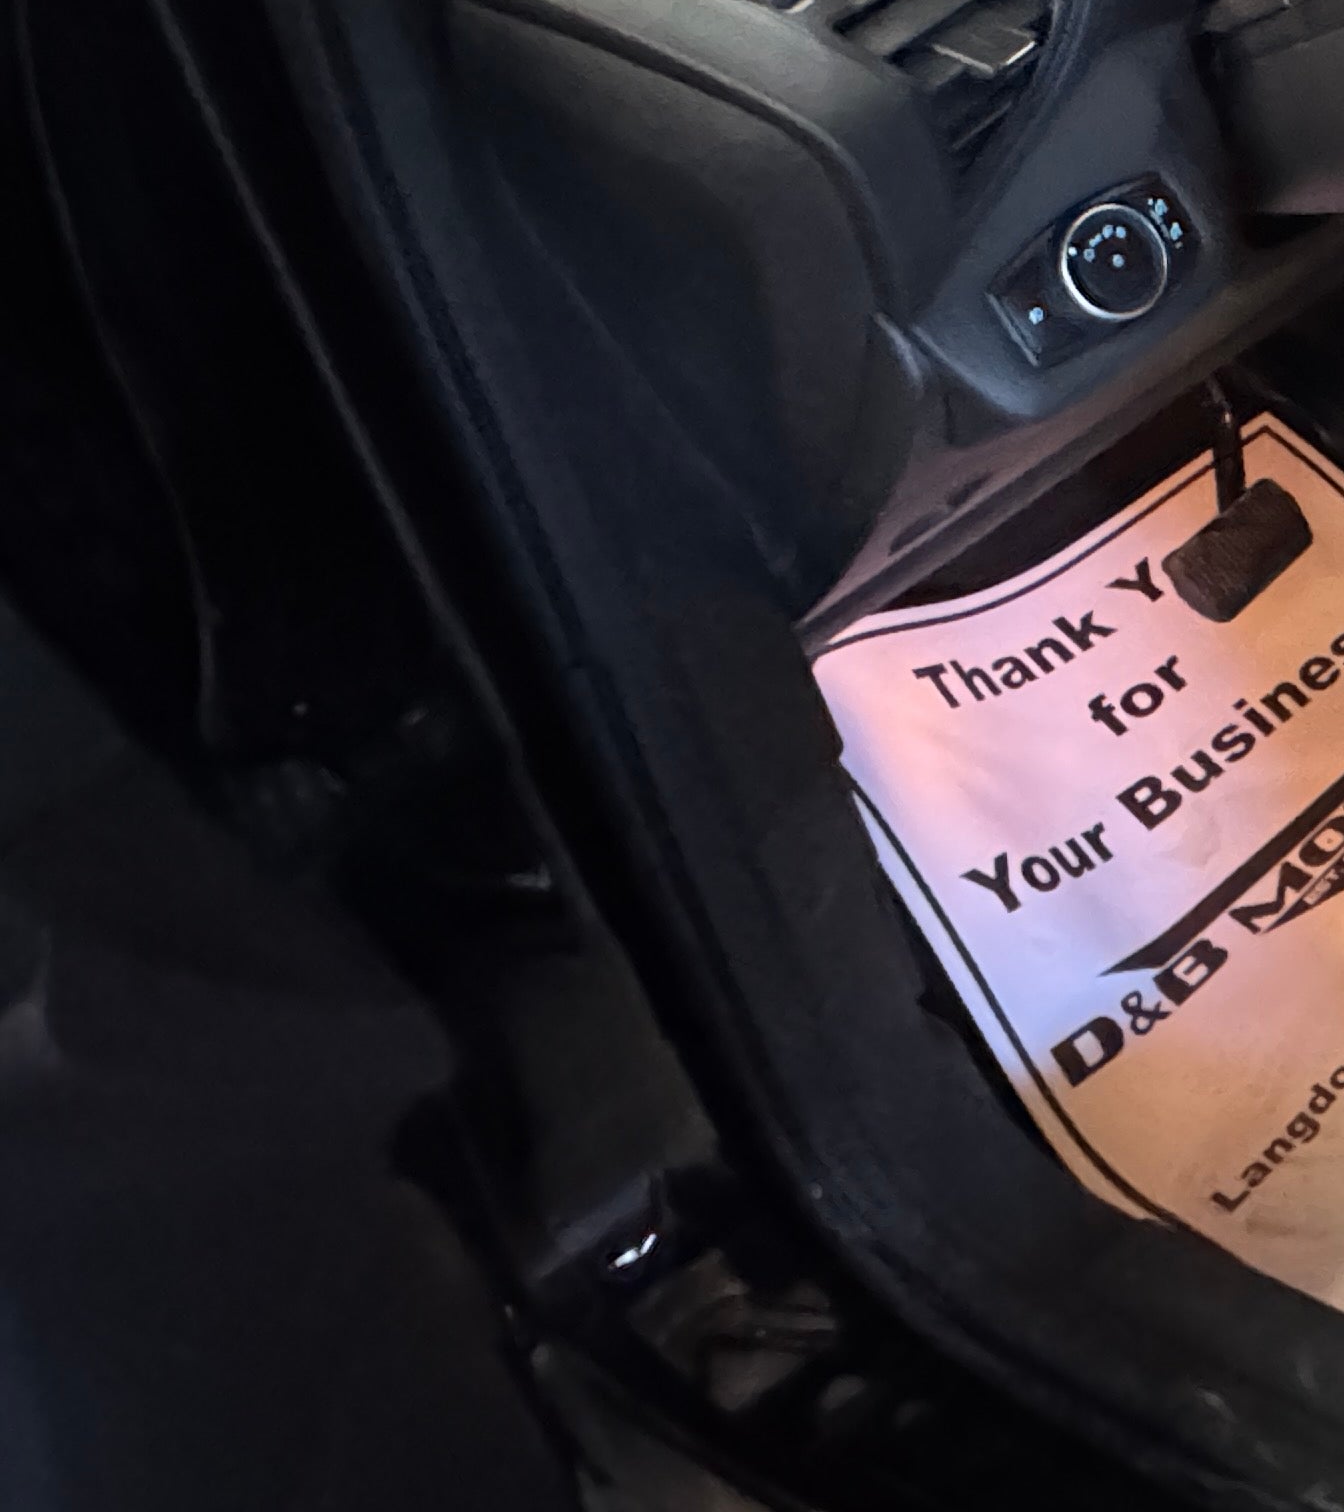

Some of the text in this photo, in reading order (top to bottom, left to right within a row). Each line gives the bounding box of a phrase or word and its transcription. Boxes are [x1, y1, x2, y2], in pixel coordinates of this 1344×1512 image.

[913, 610, 1118, 709] Thank
[1087, 654, 1189, 737] for
[960, 821, 1115, 914] Your
[1050, 938, 1230, 1088] D&B
